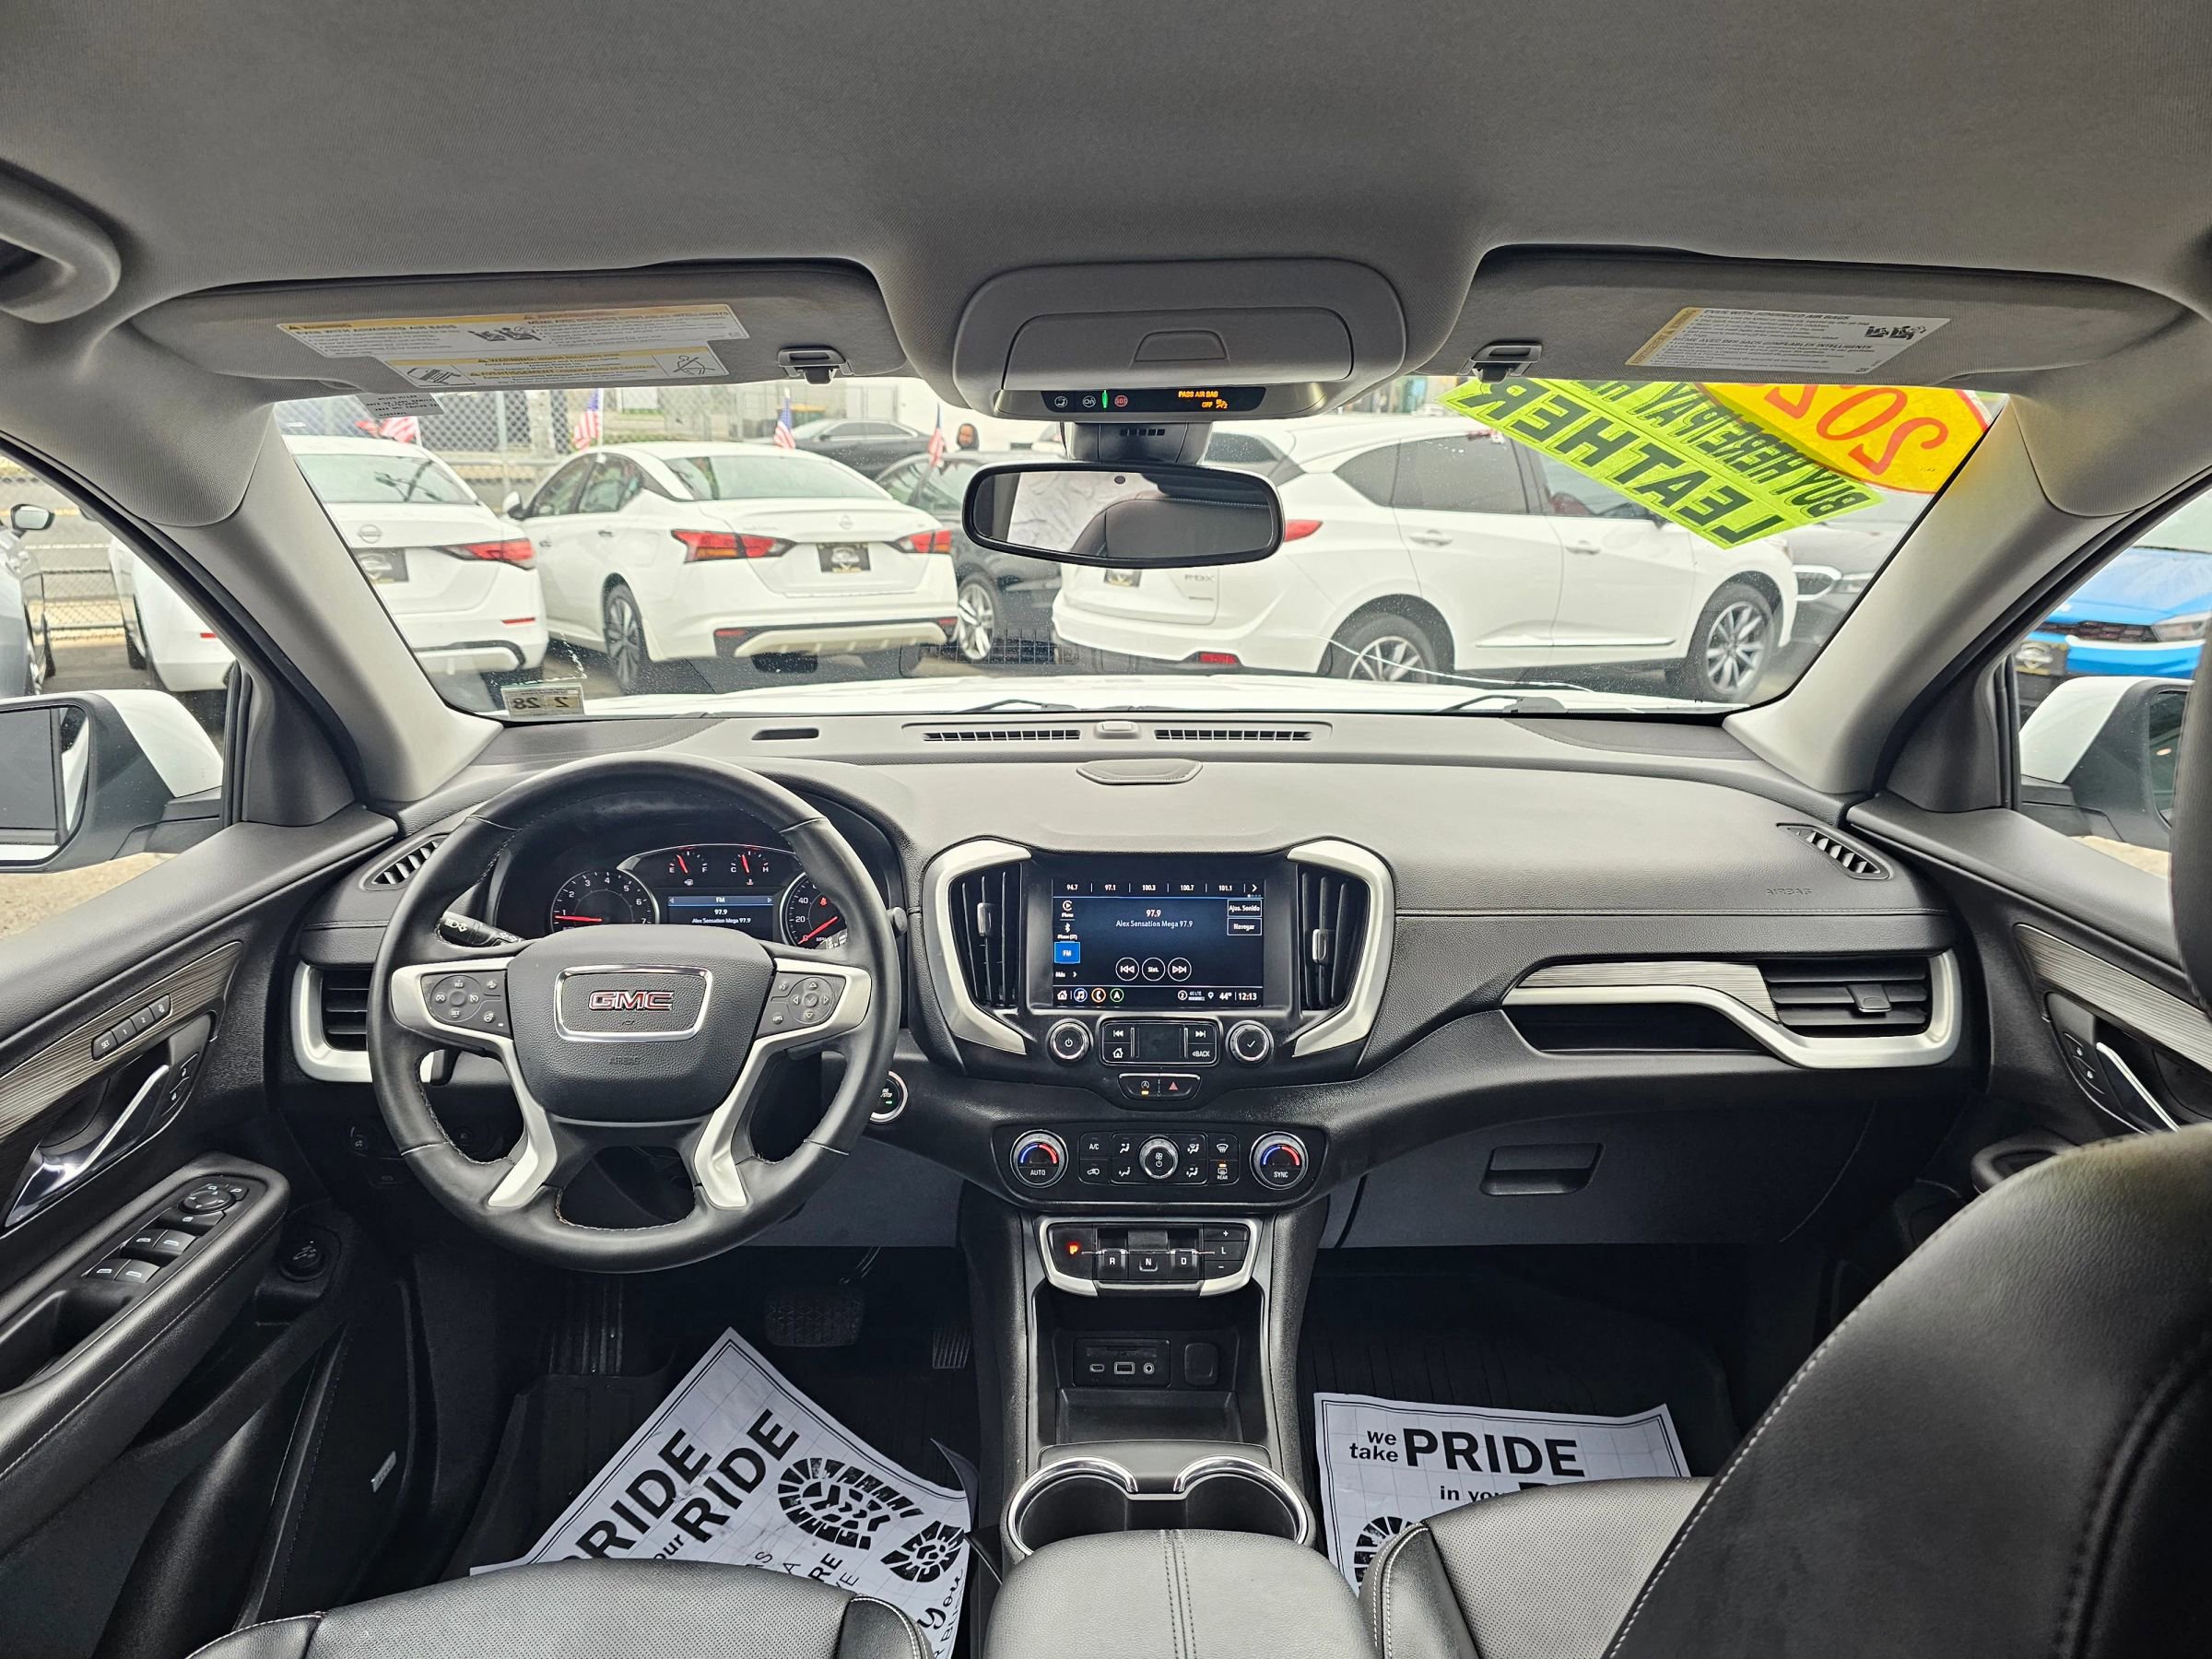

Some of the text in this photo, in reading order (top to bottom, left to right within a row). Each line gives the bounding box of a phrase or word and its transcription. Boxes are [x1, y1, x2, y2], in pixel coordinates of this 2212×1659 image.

[1147, 909, 1161, 917] 97.9
[1161, 920, 1179, 929] Mega
[587, 990, 675, 1011] GMC
[1239, 993, 1257, 1001] 12:13
[100, 1040, 111, 1049] SET
[1069, 1245, 1078, 1254] P
[1221, 1246, 1226, 1254] L
[1110, 1257, 1115, 1265] R
[1145, 1257, 1152, 1265] N
[1182, 1257, 1187, 1265] D
[1367, 1430, 1397, 1445] we
[1349, 1428, 1585, 1477] take PRIDE
[672, 1408, 800, 1544] RIDE
[563, 1429, 712, 1559] RIDE
[1440, 1486, 1460, 1500] in
